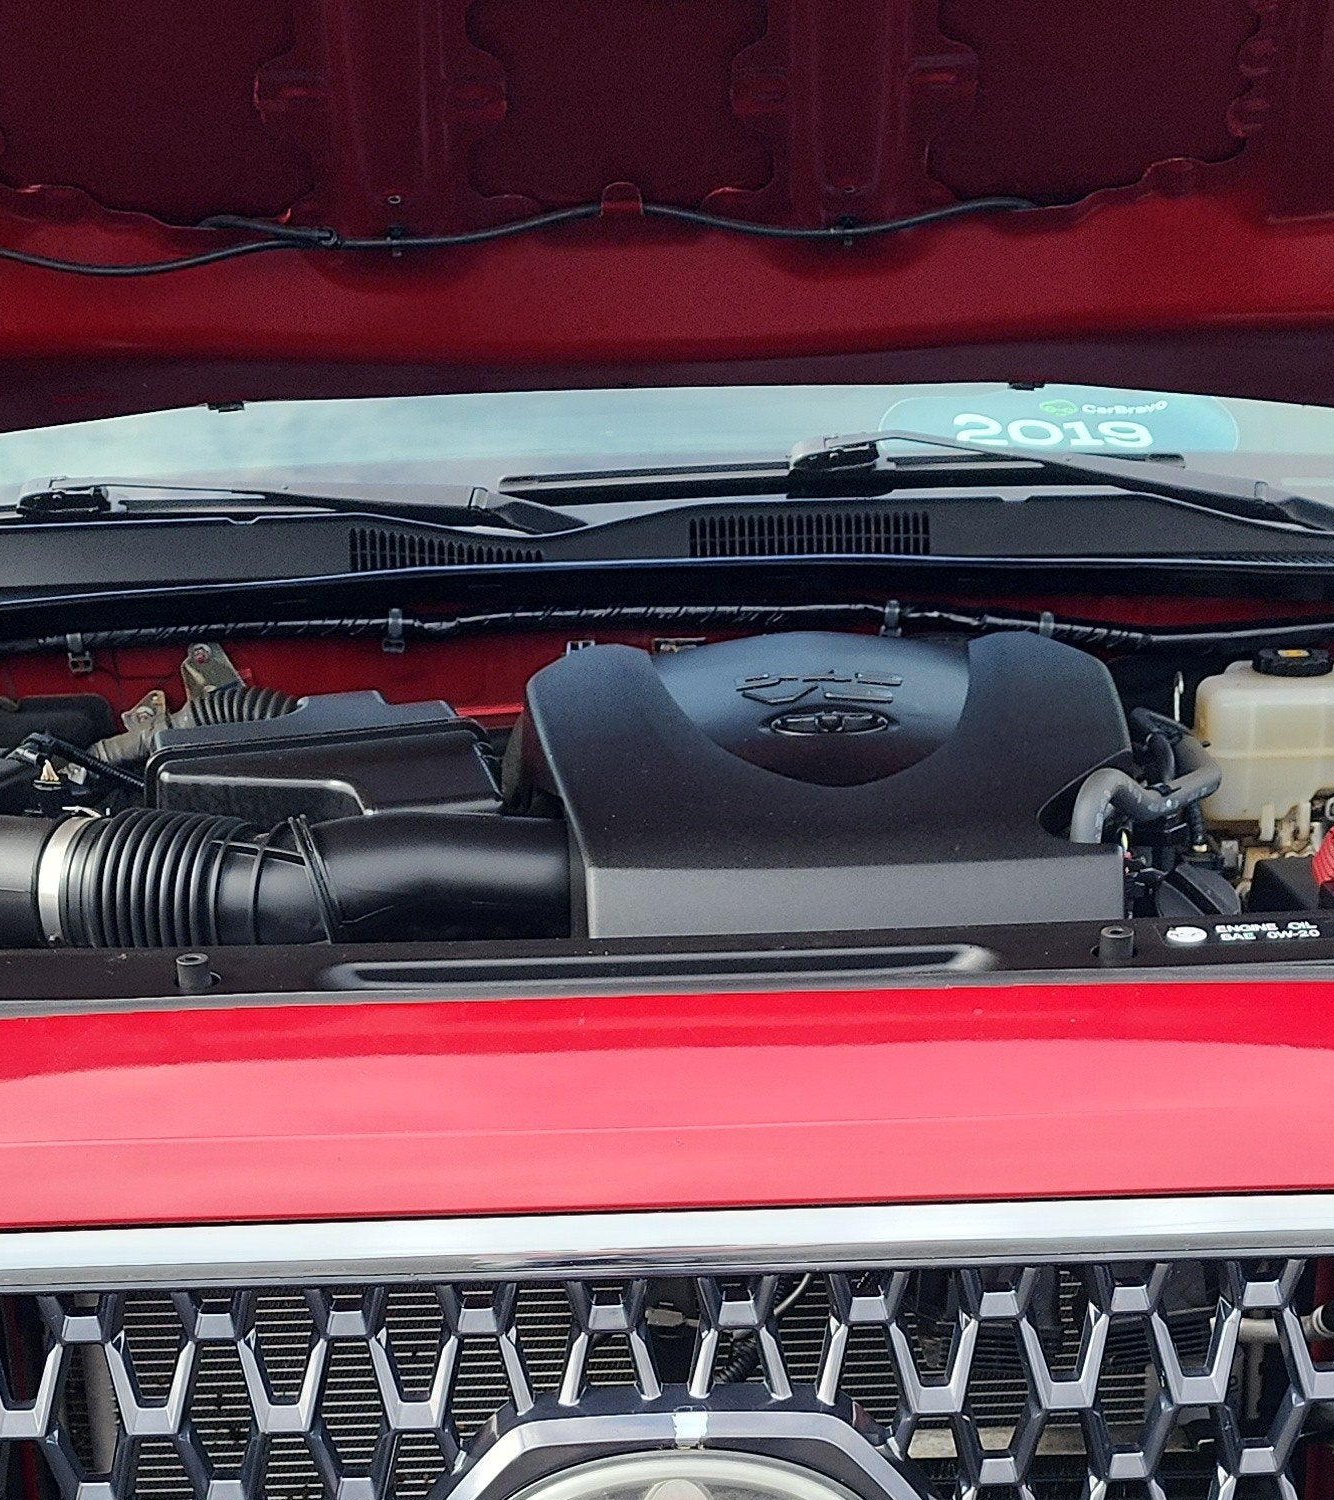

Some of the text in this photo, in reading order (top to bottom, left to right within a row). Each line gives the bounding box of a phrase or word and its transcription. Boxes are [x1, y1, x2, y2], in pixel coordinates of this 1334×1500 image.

[1081, 399, 1168, 416] CarBravo
[952, 412, 1155, 448] 2019
[1215, 920, 1317, 934] ENGINE OIL
[1220, 932, 1256, 941] SAE
